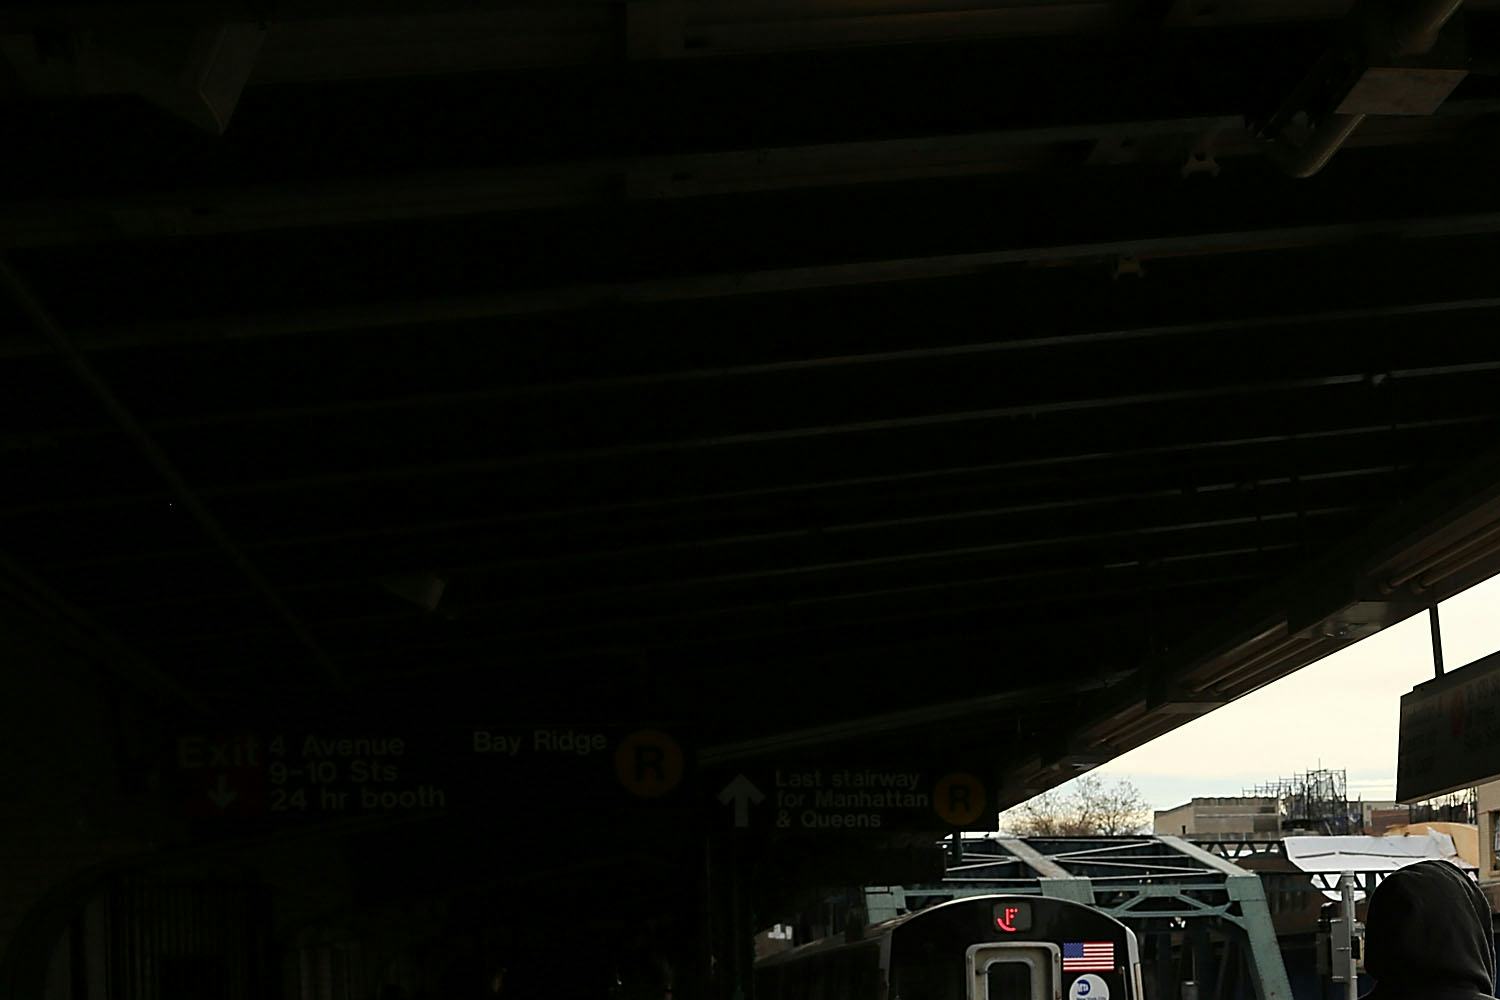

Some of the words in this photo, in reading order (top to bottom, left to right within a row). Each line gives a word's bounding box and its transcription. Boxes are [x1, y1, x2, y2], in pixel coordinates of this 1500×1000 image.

[177, 733, 261, 769] Exit
[269, 735, 286, 757] 4
[302, 734, 406, 757] Avenue
[473, 731, 523, 755] Bay
[534, 729, 608, 755] Ridge
[269, 760, 337, 784] 9-10
[351, 760, 400, 783] Sts
[635, 746, 665, 785] R
[776, 769, 823, 788] Last
[831, 769, 921, 790] stairway
[271, 787, 307, 811] 24
[320, 786, 351, 808] hr
[361, 784, 447, 808] booth
[776, 790, 805, 808] for
[815, 789, 929, 808] Manhattan
[948, 783, 973, 814] R
[776, 810, 791, 828] &
[801, 810, 881, 829] Queens
